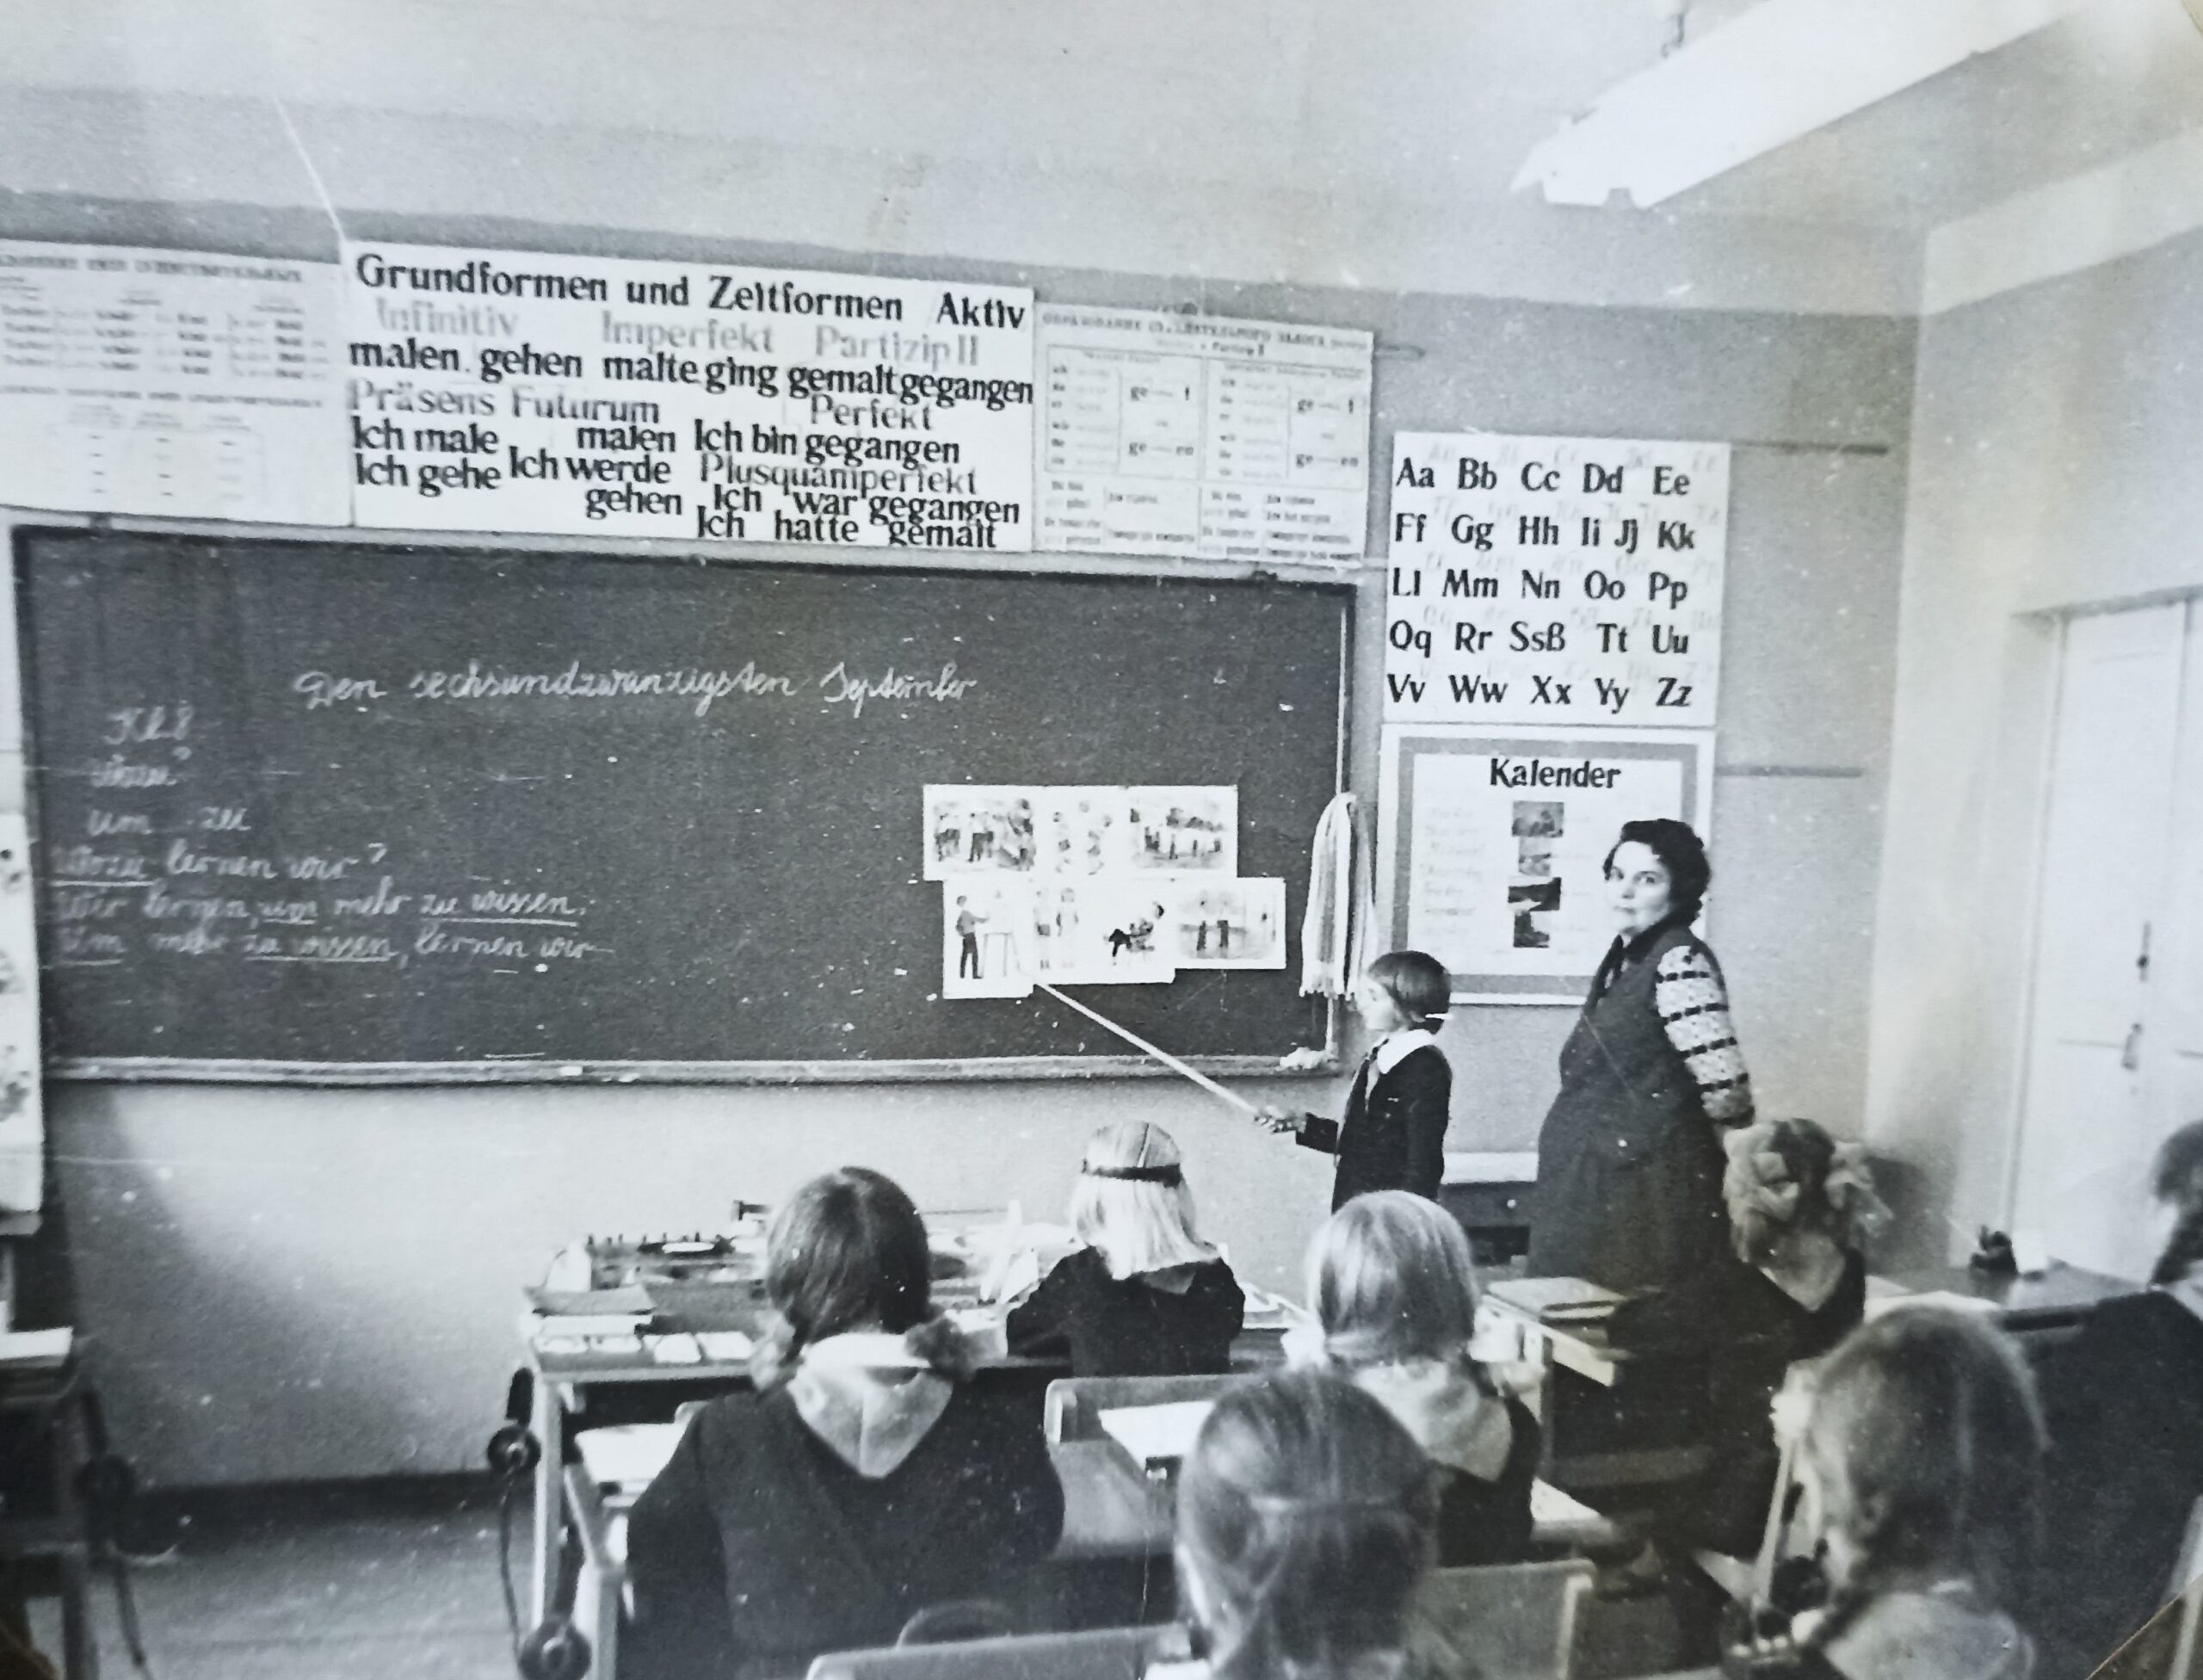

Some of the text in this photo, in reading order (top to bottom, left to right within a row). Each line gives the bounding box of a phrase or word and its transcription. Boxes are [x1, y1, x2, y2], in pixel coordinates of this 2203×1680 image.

[357, 253, 608, 301] Grundformen
[626, 276, 688, 306] und
[709, 275, 903, 321] Zeitformen
[937, 291, 1026, 329] Aktiv
[376, 297, 516, 337] Infinitiv
[602, 310, 774, 355] Imperfekt
[480, 343, 583, 384] gehen
[602, 351, 698, 384] malte
[705, 356, 779, 398] ging
[787, 364, 897, 399] gemalt
[899, 373, 1034, 411] gegangen
[349, 379, 935, 430] Präsens Futurum Perfekt
[352, 416, 960, 471] Ich male malen Ich bin gegangen
[355, 445, 978, 498] Ich gehe Ich werde Plusquamperfekt
[1395, 457, 1690, 496] Aa Bb Cc Dd Ee
[585, 482, 682, 521] gehen
[713, 484, 762, 513] Ich
[791, 491, 857, 516] war
[868, 495, 1021, 527] gegangen
[697, 505, 997, 548] Ich hatte gemalt
[1395, 513, 1428, 542] Ff
[1451, 514, 1494, 552] Gg
[1518, 516, 1559, 546] Hh
[1582, 516, 1601, 547] Ii
[1614, 518, 1638, 553] Jj
[1657, 521, 1695, 551] Kk
[1392, 567, 1688, 609] Ll Mm Nn Oo Pp
[1389, 620, 1432, 658] Qq
[1454, 621, 1493, 654] Rr
[1595, 622, 1629, 653] Tt
[1651, 624, 1689, 654] Uu
[819, 661, 978, 719] September
[1387, 673, 1694, 714] Vv Ww Xx Yy Zz
[1490, 758, 1621, 788] Kalender
